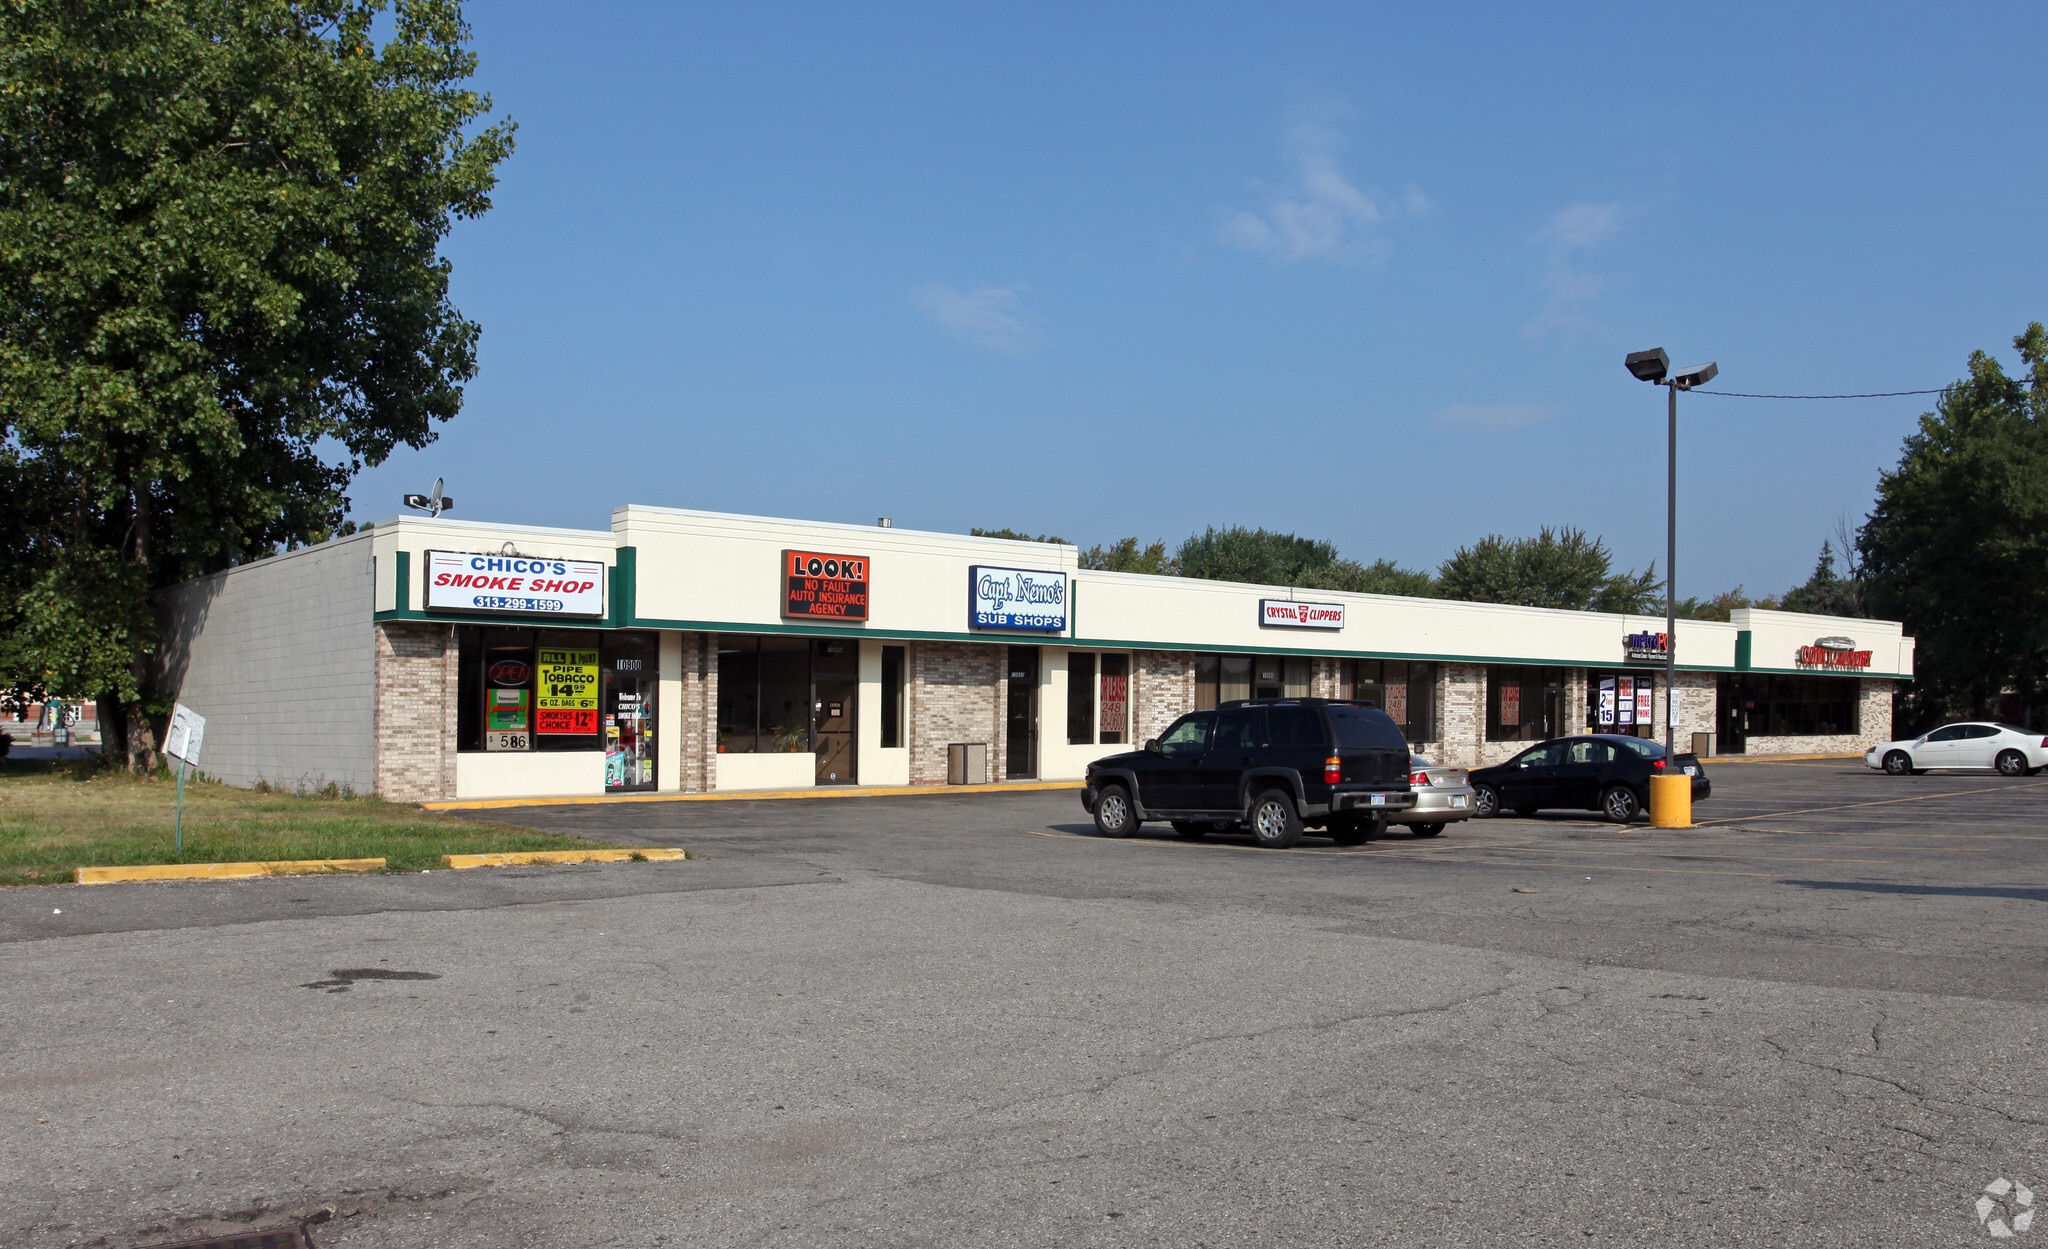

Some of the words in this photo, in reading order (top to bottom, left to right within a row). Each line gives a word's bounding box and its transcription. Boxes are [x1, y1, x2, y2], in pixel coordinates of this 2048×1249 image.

[470, 557, 567, 575] CHICO'S
[794, 556, 863, 580] LOOK!
[434, 573, 524, 591] SMOKE
[529, 579, 594, 594] SHOP
[805, 580, 818, 591] NO
[823, 581, 851, 593] FAULT
[790, 590, 815, 602] AUTO
[819, 592, 865, 605] INSURANCE
[978, 574, 1013, 610] Capt.
[1015, 573, 1063, 604] Nemo's
[476, 596, 561, 611] 313-299-1599
[809, 603, 847, 615] AGENCY
[978, 614, 1007, 624] SUB
[1014, 615, 1062, 627] SHOPS
[1267, 606, 1297, 619] CRYSTAL
[1309, 609, 1342, 622] CLIPPERS
[543, 654, 565, 662] ALL
[570, 653, 577, 664] 1
[1802, 645, 1827, 665] COIN
[1829, 650, 1872, 667] LAUNDRY
[488, 665, 530, 681] OPEN
[543, 670, 594, 684] TOBACCO
[1100, 677, 1108, 701] OR
[1102, 702, 1121, 713] 248
[1388, 700, 1402, 709] 248
[1599, 693, 1606, 708] 2
[1637, 694, 1650, 707] FREE
[540, 712, 573, 720] SMOKERS
[1600, 710, 1613, 721] 15
[540, 721, 571, 729] CHOICE
